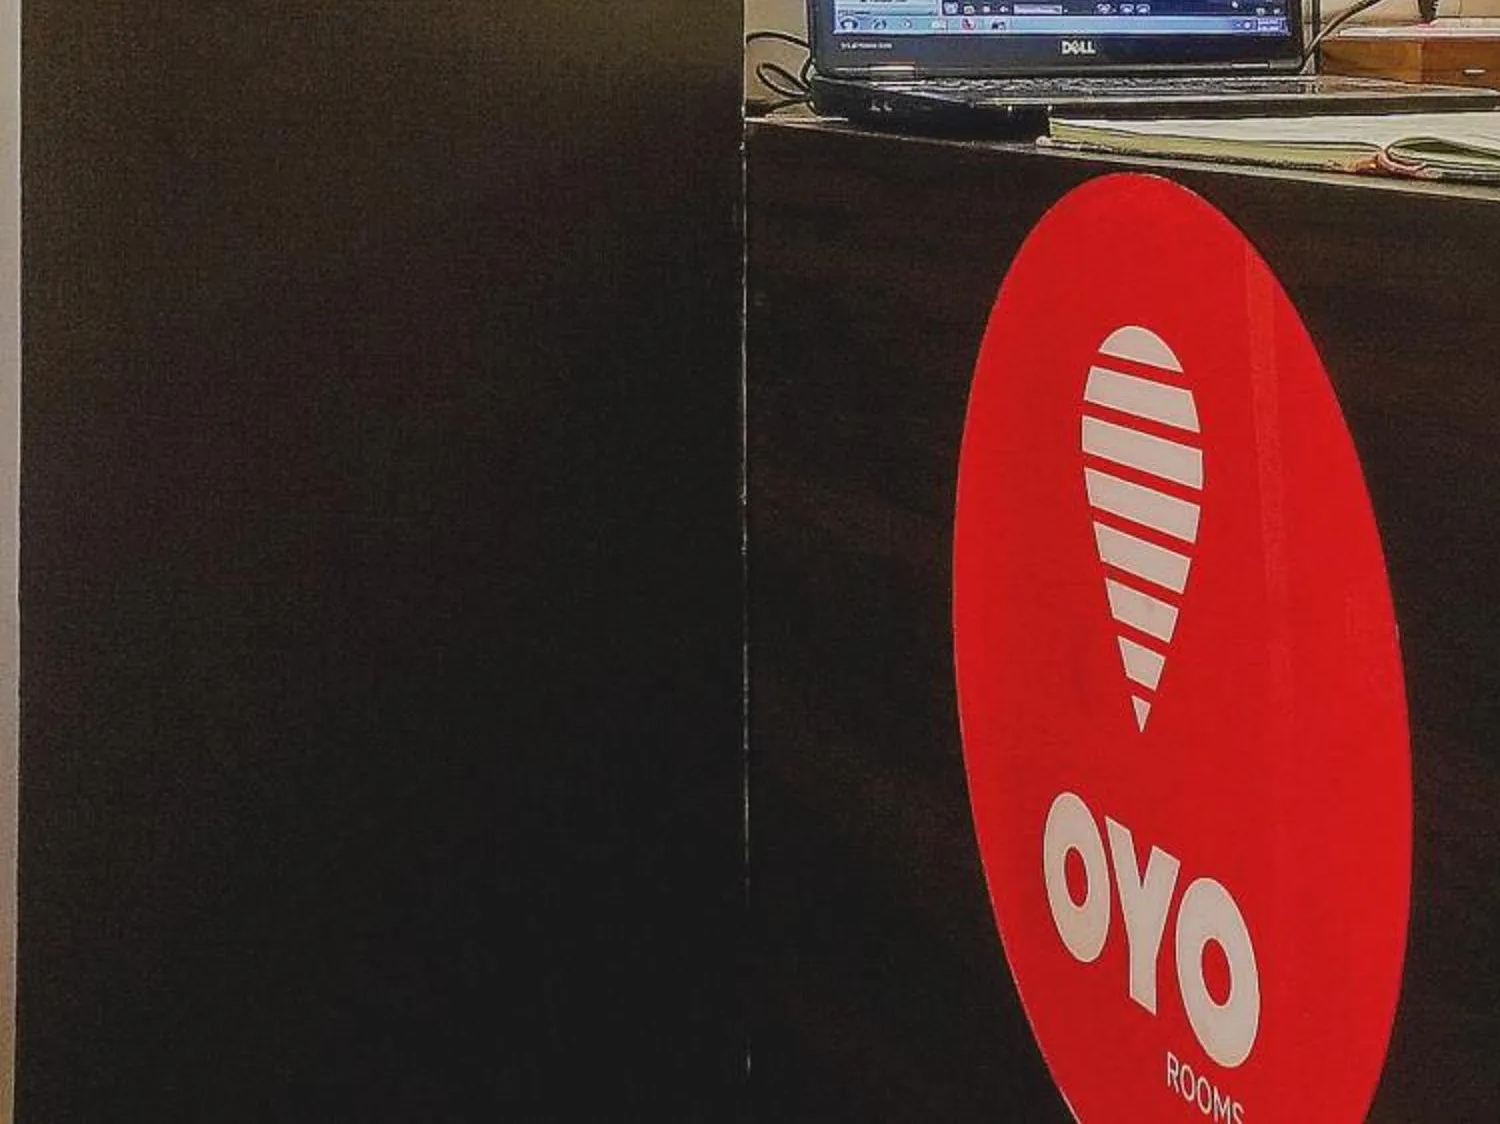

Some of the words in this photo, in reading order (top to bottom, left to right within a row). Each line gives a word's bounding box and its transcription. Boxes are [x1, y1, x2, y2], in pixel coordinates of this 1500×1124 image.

[1061, 39, 1097, 56] DELL
[1043, 791, 1260, 1066] OYO
[1167, 1051, 1245, 1124] ROOMS
